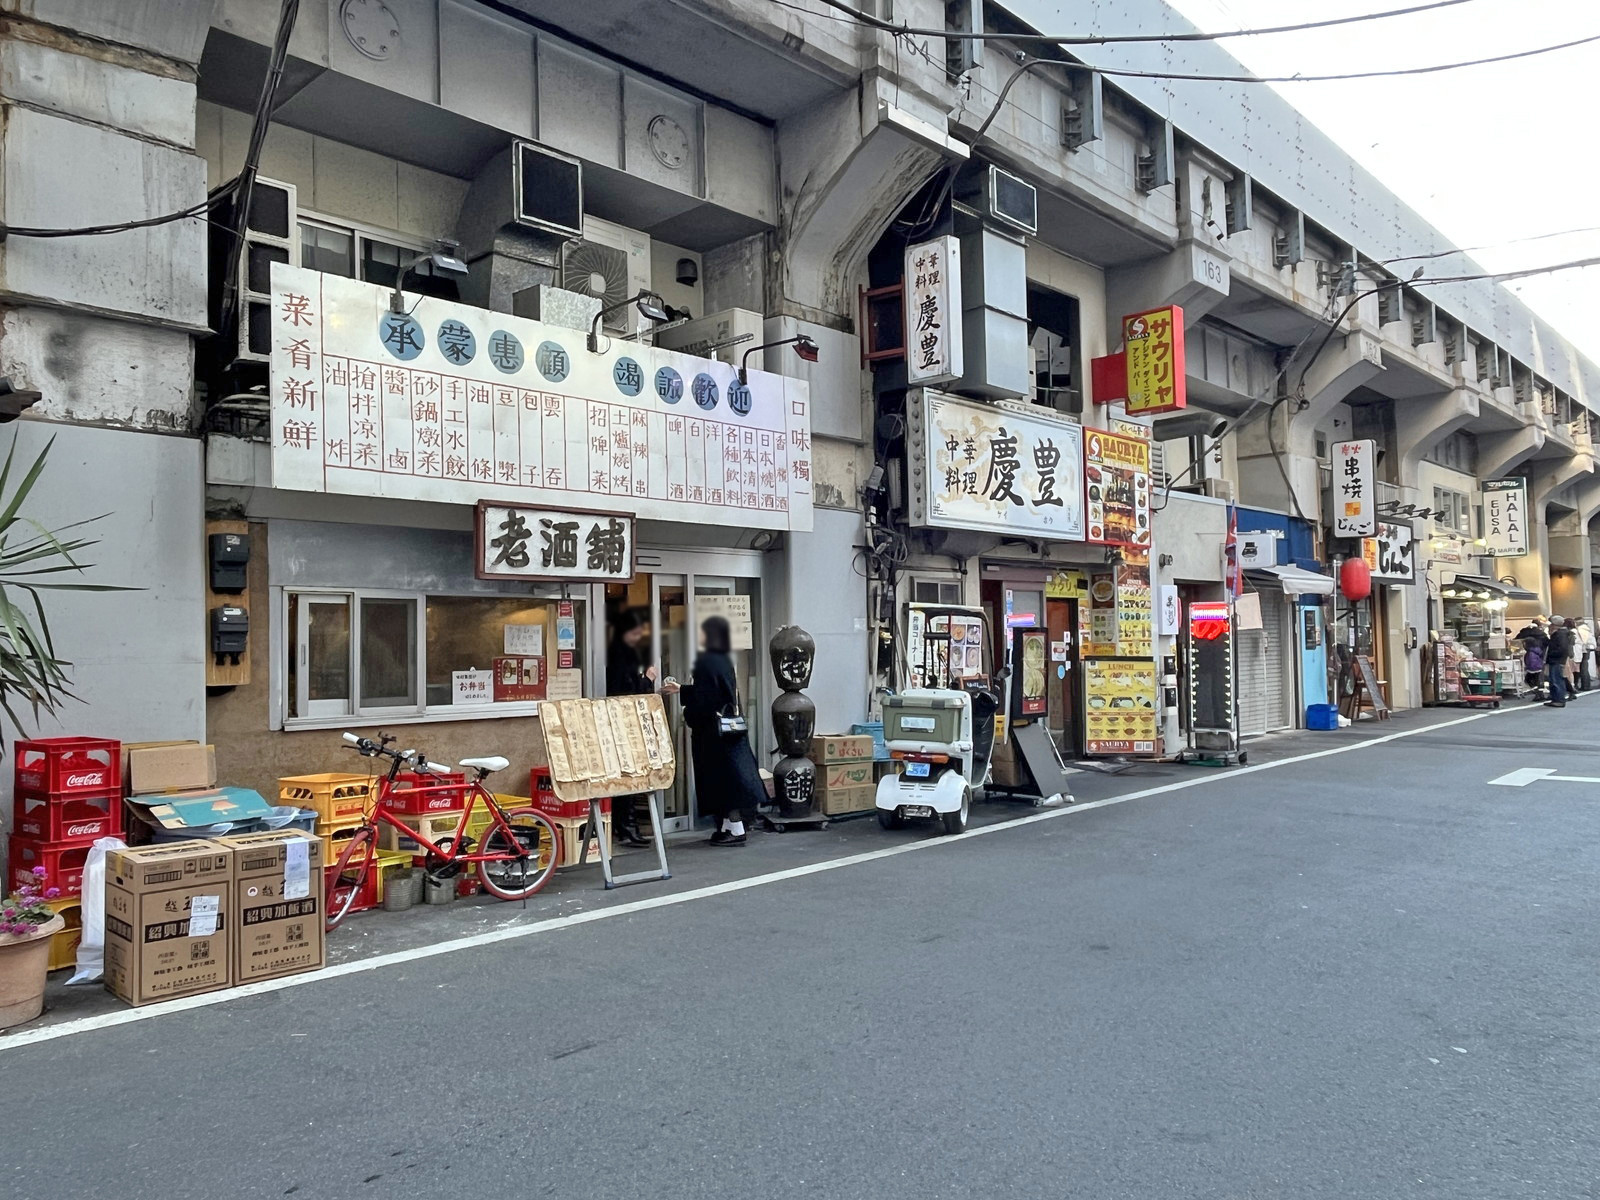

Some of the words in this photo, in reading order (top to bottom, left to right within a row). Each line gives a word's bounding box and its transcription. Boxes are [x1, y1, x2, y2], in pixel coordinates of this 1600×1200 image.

[915, 252, 939, 272] 中華
[915, 270, 941, 289] 料理
[1203, 259, 1222, 284] 163
[280, 293, 319, 450] 菜肴新鮮
[1132, 347, 1140, 369] アンド
[1132, 370, 1141, 386] バー
[1142, 339, 1150, 369] アジアン
[1150, 318, 1172, 404] サウリヤ
[325, 362, 349, 463] 油炸
[1142, 369, 1151, 408] ダイニング
[444, 380, 467, 477] 手工水餃
[520, 392, 538, 484] 包子
[544, 395, 562, 486] 雲吞
[590, 405, 609, 490] 招牌菜
[632, 410, 647, 495] 麻辣串
[668, 418, 684, 499] 啤酒
[791, 400, 810, 495] 口味獨一
[945, 434, 977, 465] 中華
[1103, 437, 1145, 459] SAURYA
[689, 421, 704, 502] 白酒
[706, 424, 723, 504] 洋酒
[724, 426, 740, 505] 各種飲料
[743, 431, 757, 507] 日本清酒
[945, 466, 978, 495] 料理
[1341, 456, 1362, 499] 串焼
[1337, 518, 1371, 535] じんご
[1490, 499, 1501, 535] EUSA
[1506, 492, 1519, 543] HALAL
